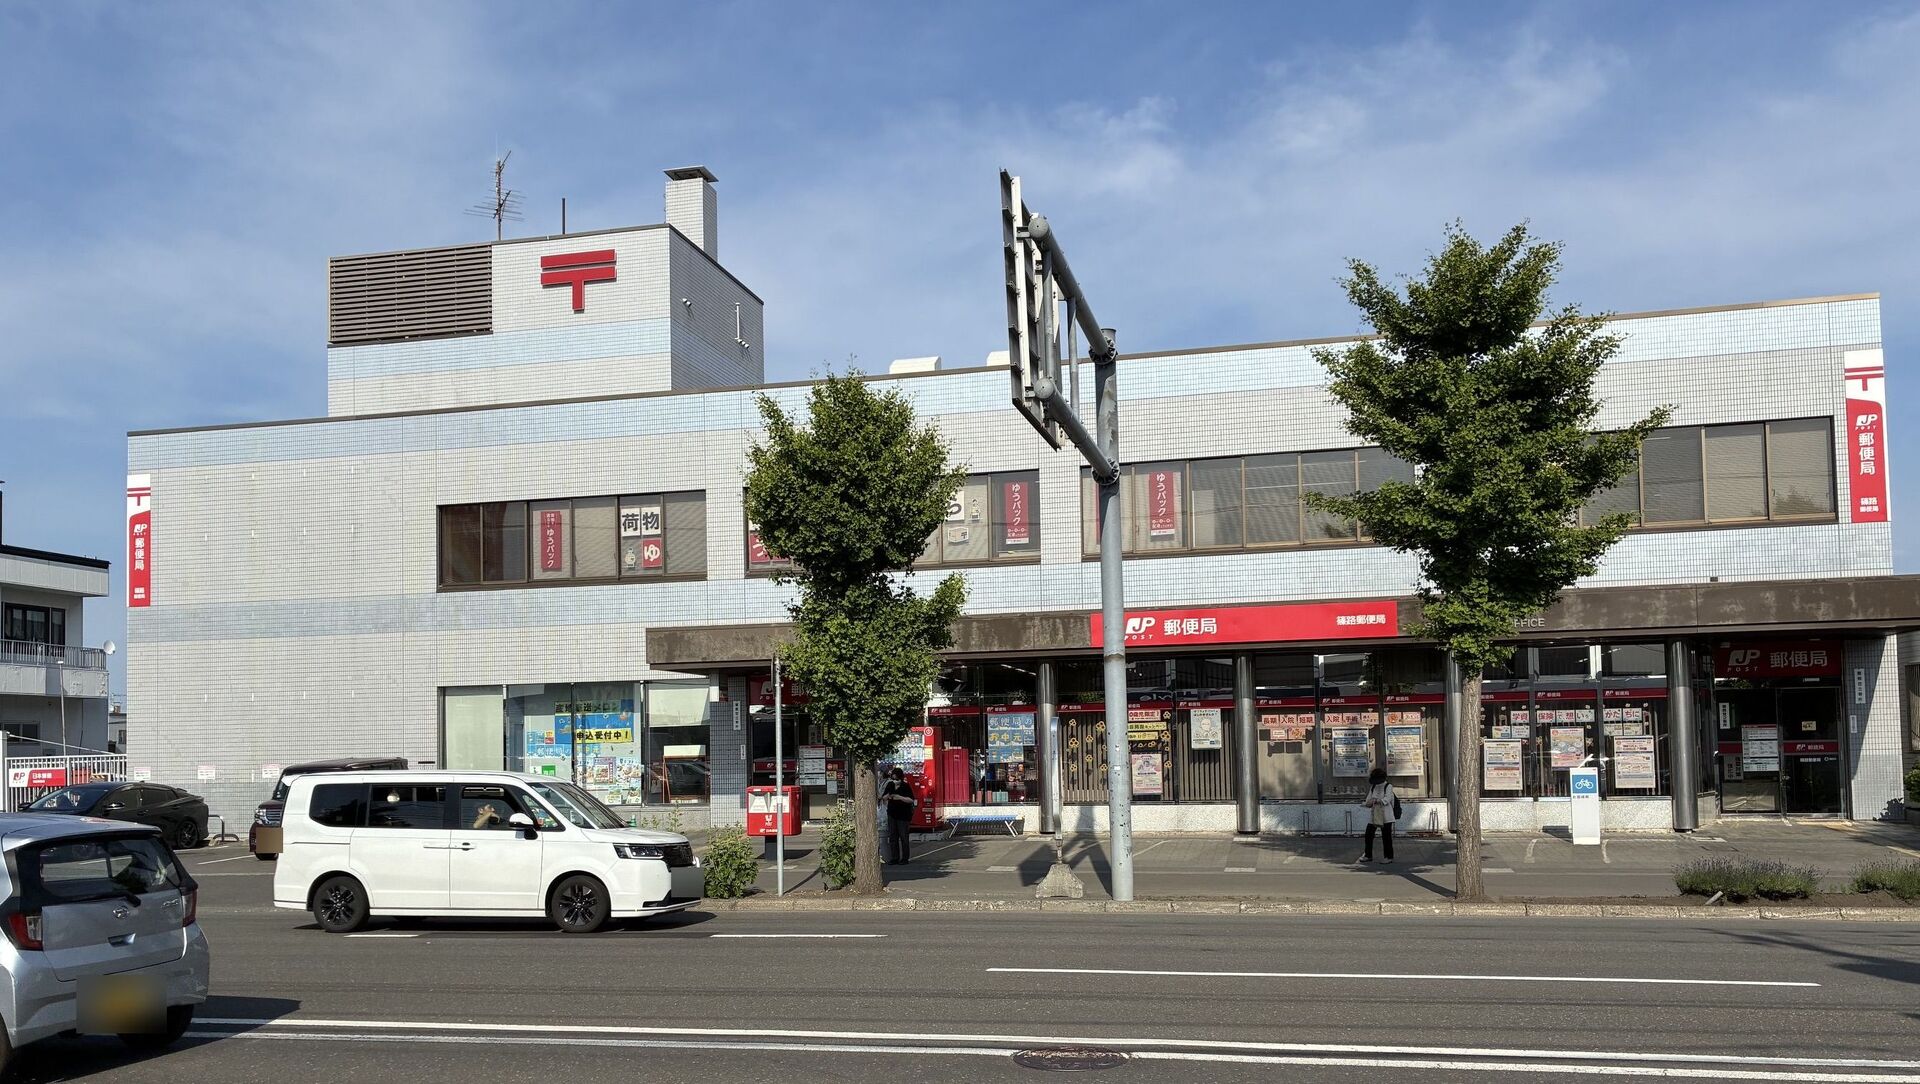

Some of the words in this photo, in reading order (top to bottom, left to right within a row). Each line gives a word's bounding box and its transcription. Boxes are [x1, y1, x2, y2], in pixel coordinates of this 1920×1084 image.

[1859, 432, 1876, 476] 郵便局
[1156, 472, 1167, 516] ゆうパック
[1012, 483, 1021, 526] ゆうパック
[621, 512, 660, 532] 荷物
[134, 537, 145, 571] 郵便局
[546, 528, 555, 568] ゆうパック
[643, 544, 660, 562] ゆ
[1125, 617, 1156, 634] JP
[1163, 617, 1217, 636] 郵便局
[1335, 614, 1386, 626] 篠路郵便局
[1514, 618, 1545, 628] FFICE
[1728, 650, 1761, 666] JP
[1769, 650, 1828, 668] 郵便局
[989, 717, 1032, 727] 郵便局の
[1263, 717, 1278, 725] 長期
[1280, 716, 1295, 724] 入院
[1298, 716, 1314, 724] 短期
[1326, 715, 1341, 723] 入院
[1512, 713, 1529, 721] 学資
[576, 731, 628, 741] 申込受付中!
[989, 732, 1022, 742] お中元
